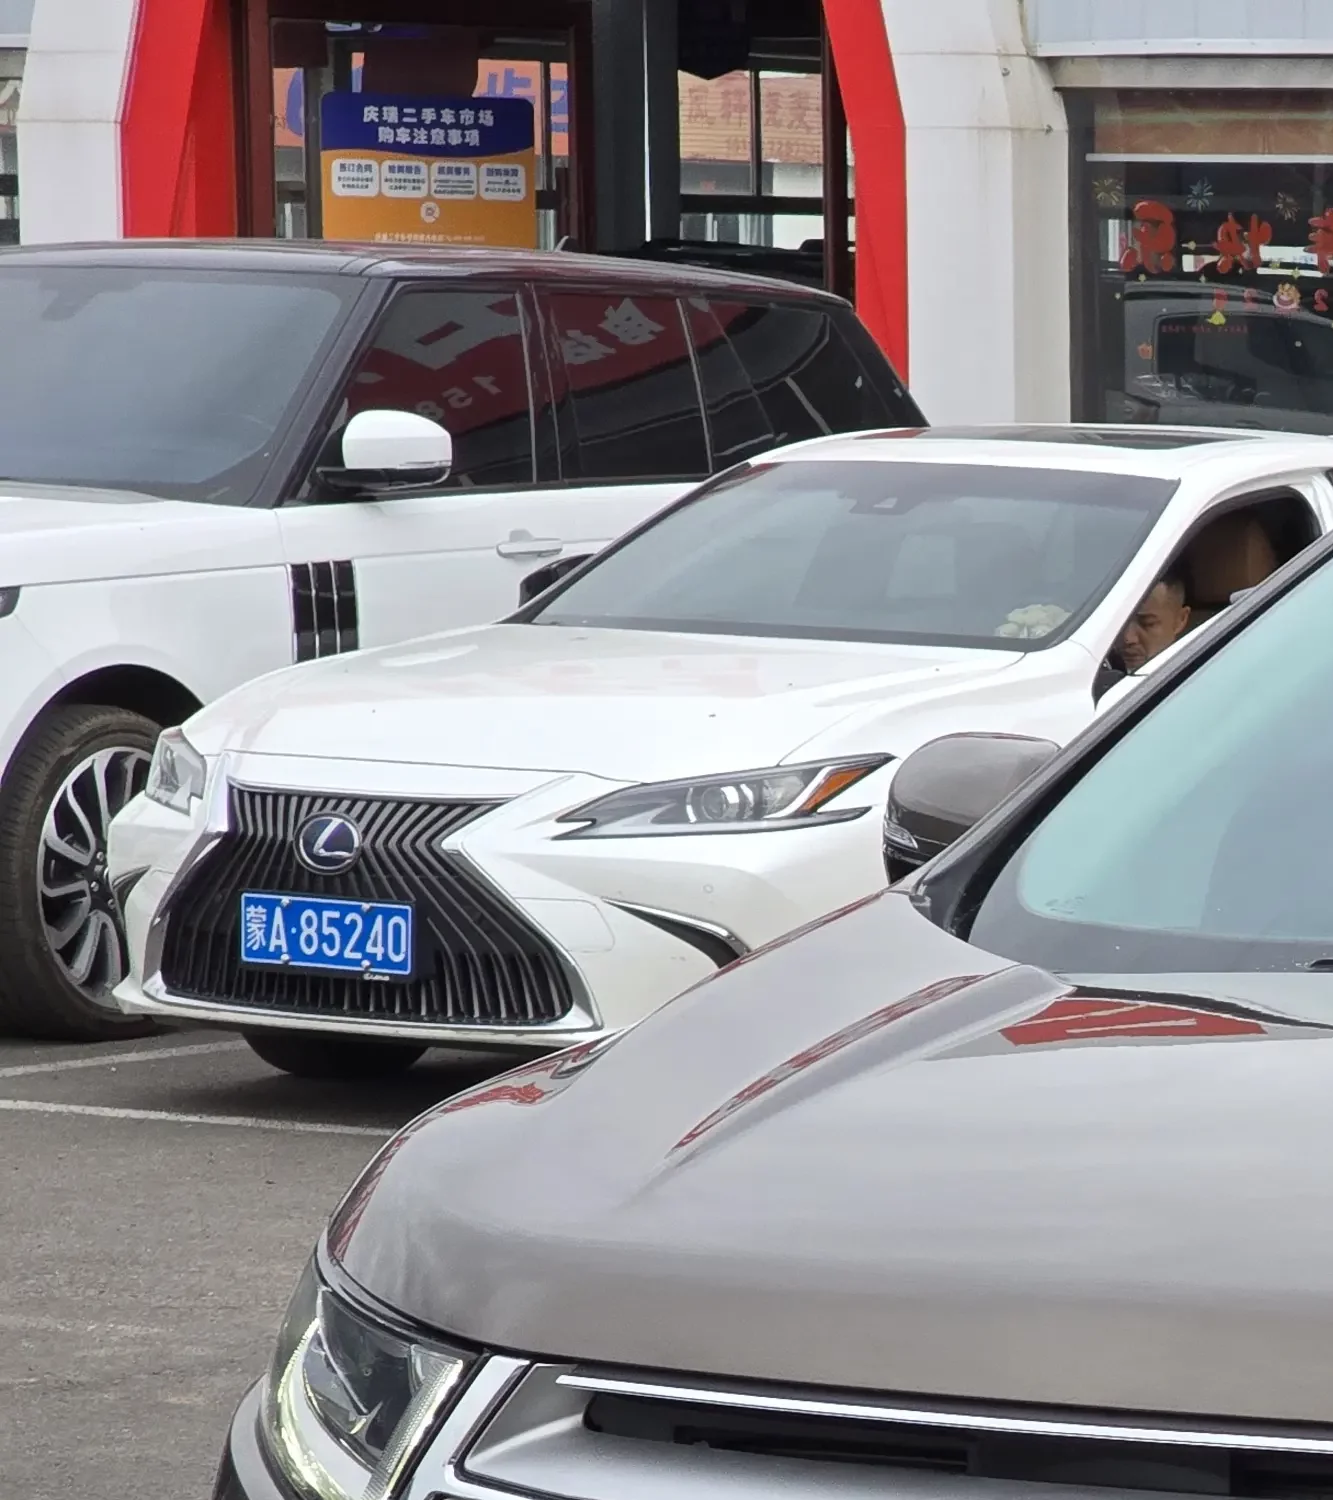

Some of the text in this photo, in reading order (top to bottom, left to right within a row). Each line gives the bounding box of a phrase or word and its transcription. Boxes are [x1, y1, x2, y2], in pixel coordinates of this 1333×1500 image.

[363, 106, 495, 127] 庆瑞二手车市场
[378, 127, 481, 147] 购车注意事项
